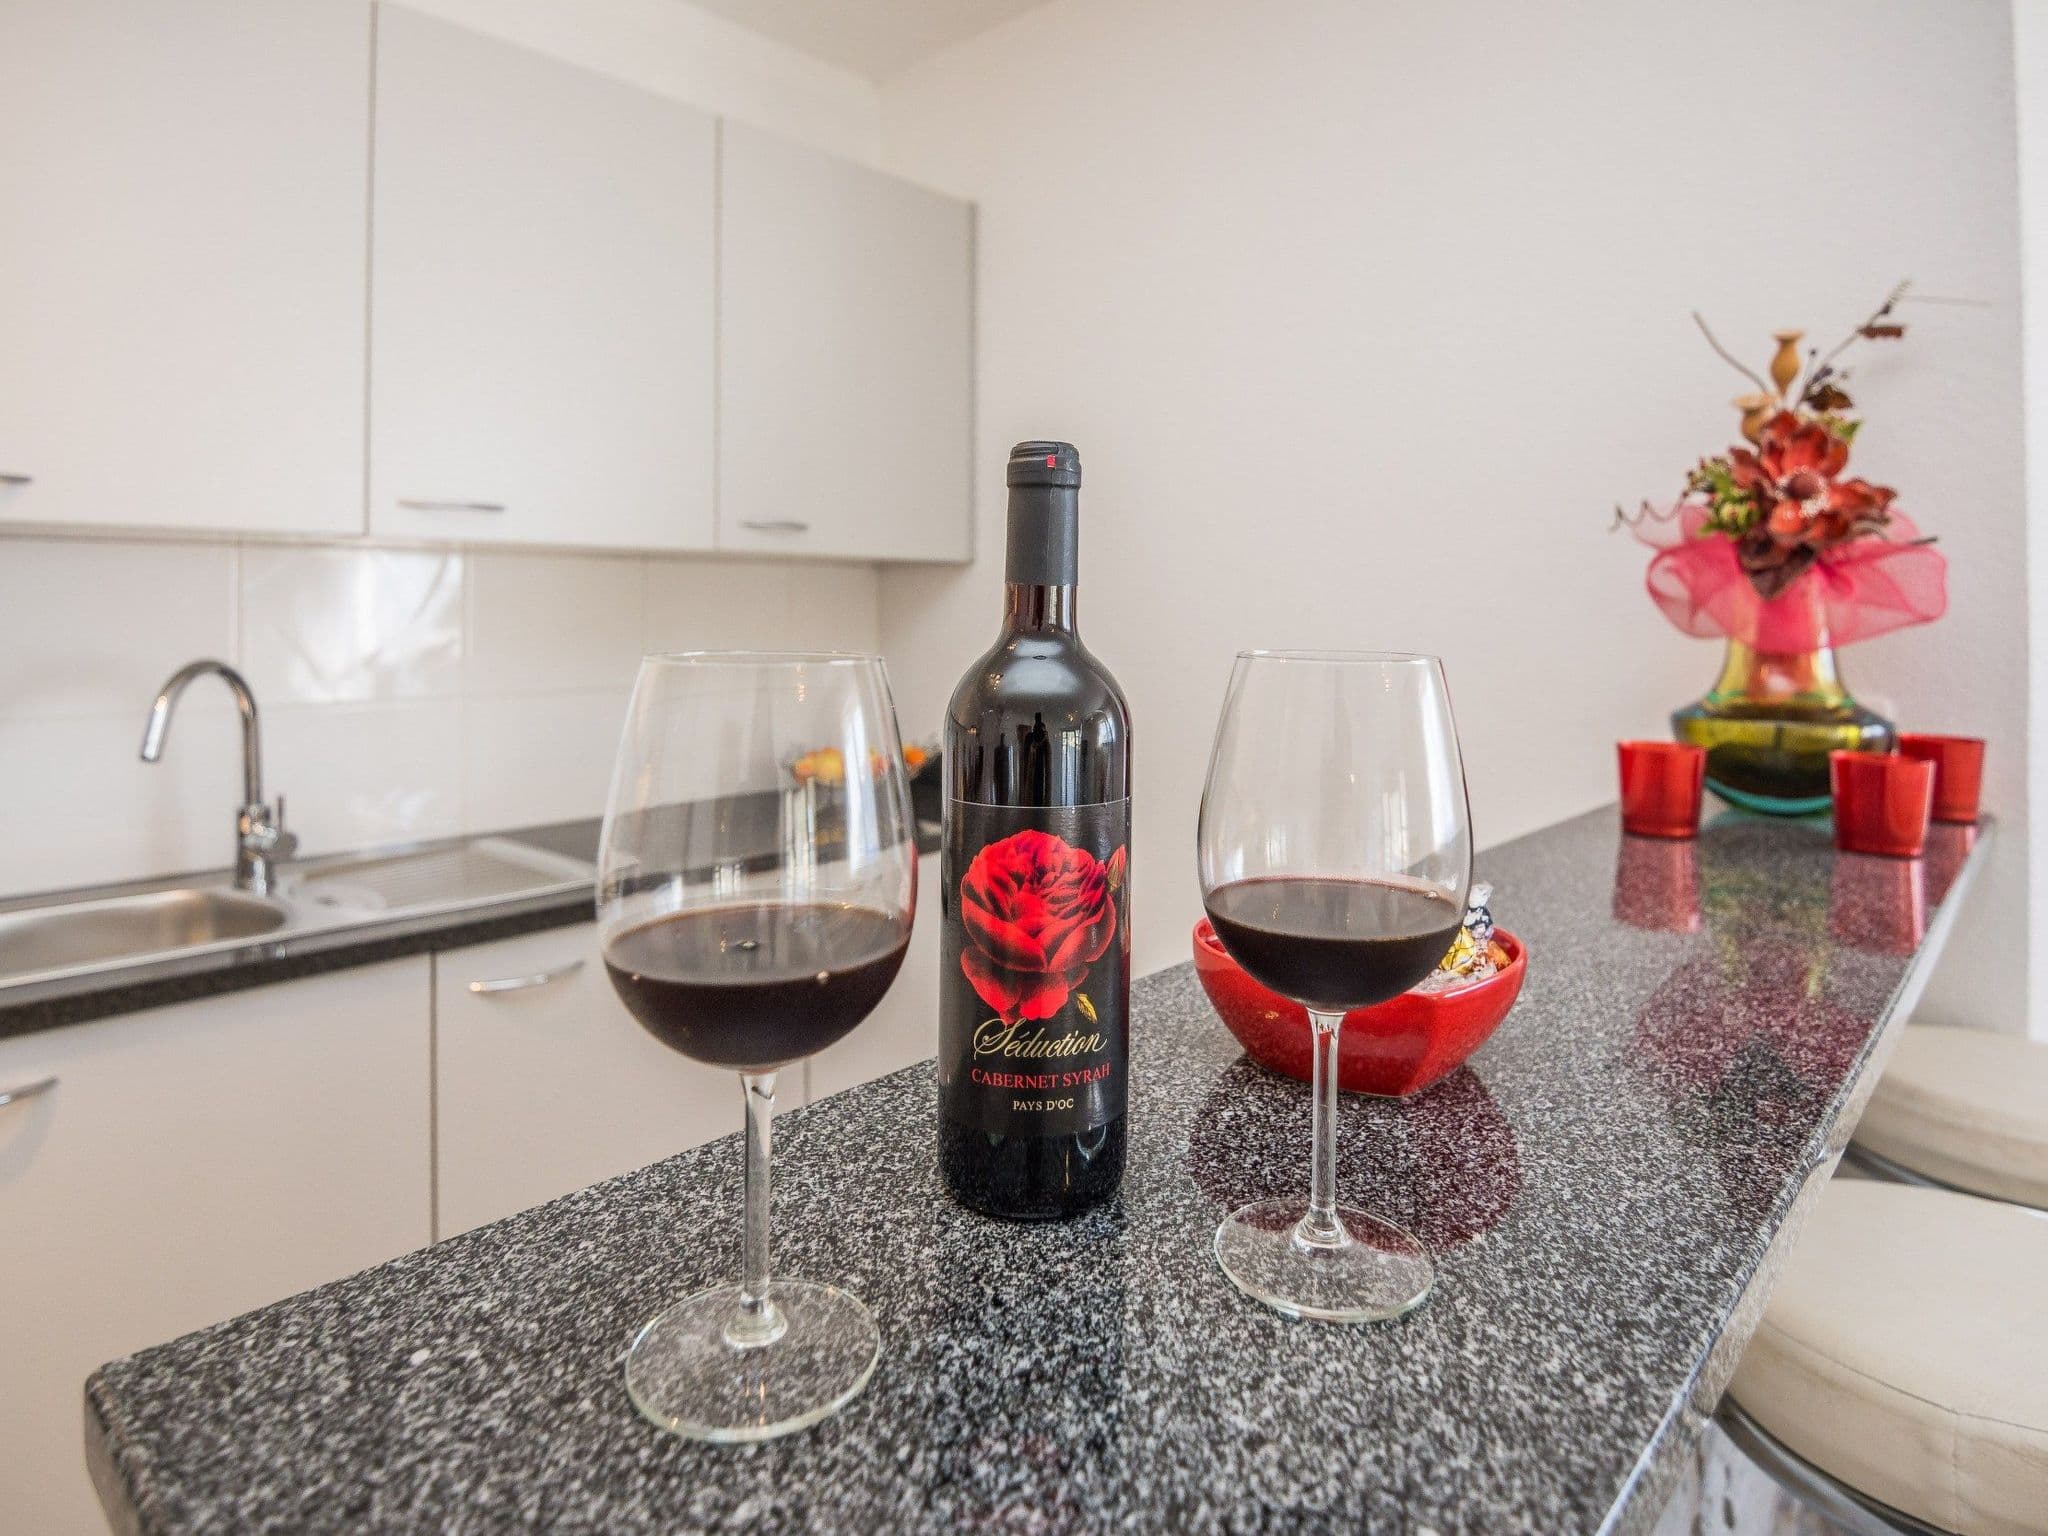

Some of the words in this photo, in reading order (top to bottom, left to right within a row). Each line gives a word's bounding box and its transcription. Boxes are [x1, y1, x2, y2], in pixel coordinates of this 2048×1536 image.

[973, 1017, 1107, 1061] Séduction
[971, 1068, 1058, 1089] CABERNET
[1062, 1062, 1111, 1087] SYRAH
[1013, 1100, 1043, 1111] PAYS
[1046, 1098, 1074, 1110] D'OC
